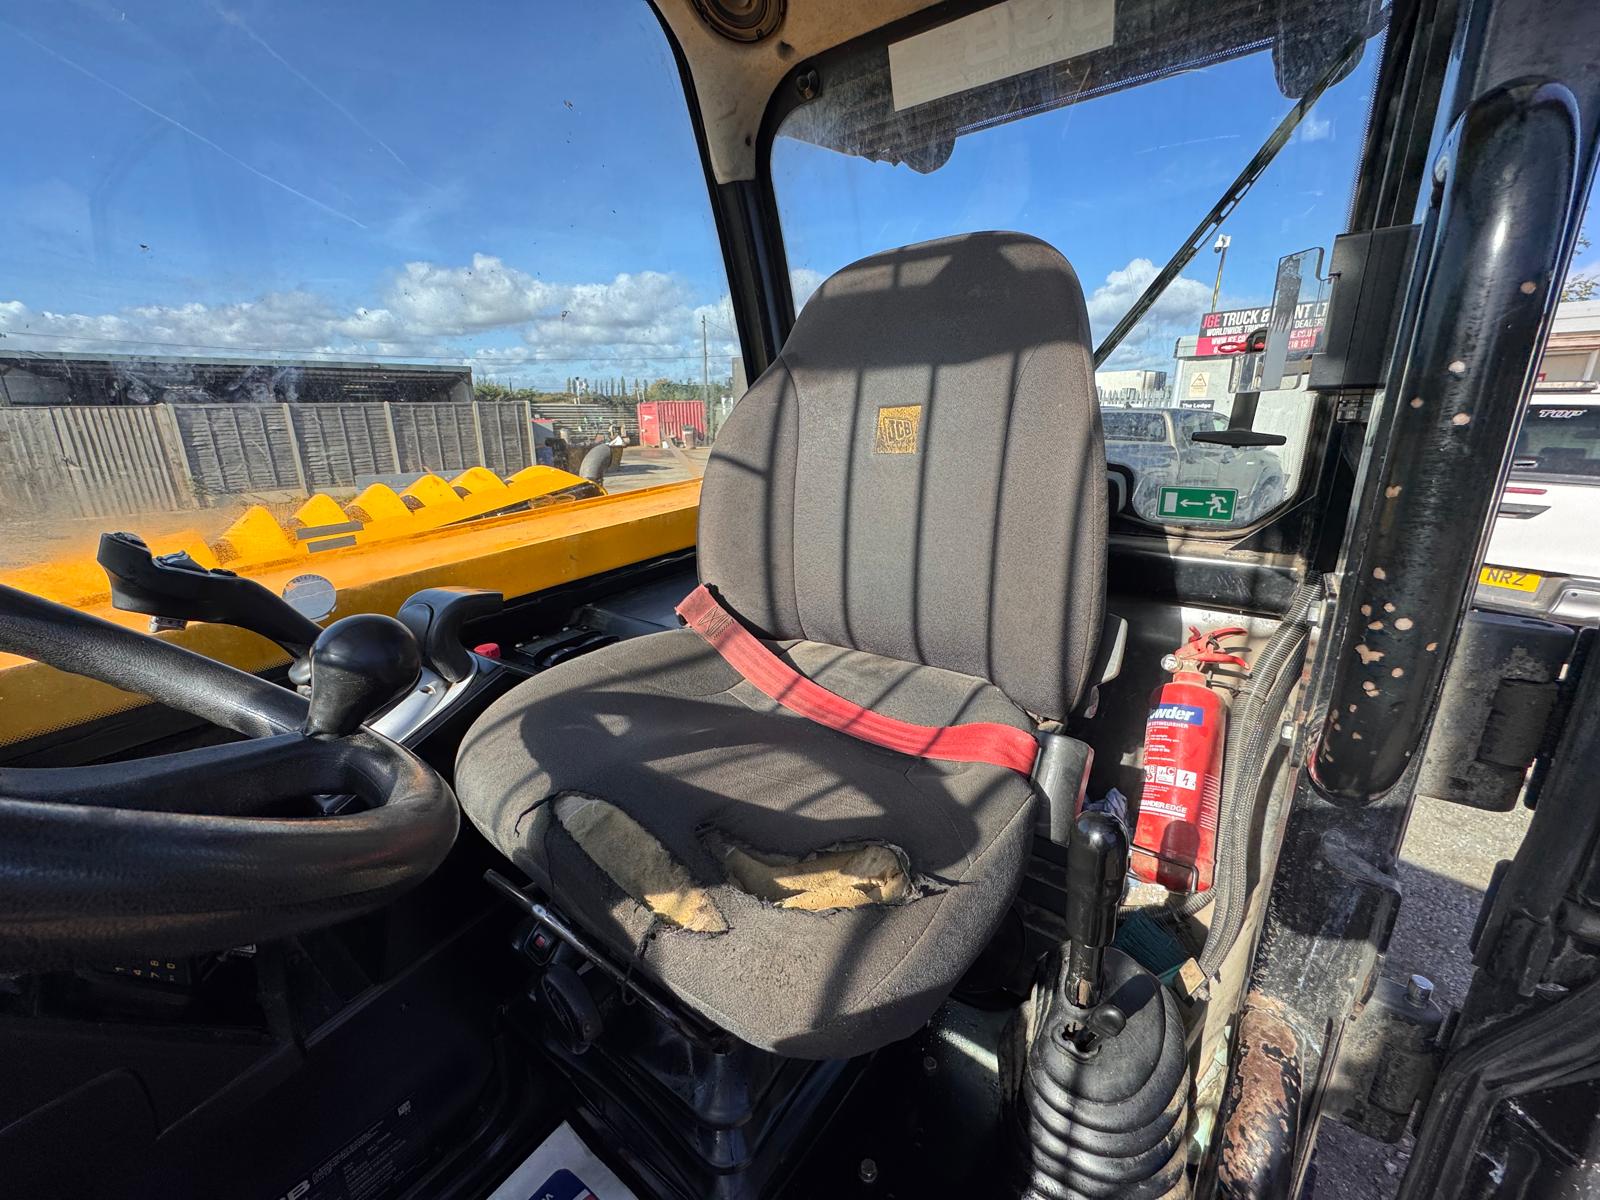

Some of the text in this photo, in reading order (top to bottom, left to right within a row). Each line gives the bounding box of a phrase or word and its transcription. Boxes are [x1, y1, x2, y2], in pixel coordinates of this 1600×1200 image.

[1222, 310, 1260, 326] TRUCK
[1260, 308, 1270, 322] &
[1206, 326, 1243, 337] WORLDWIDE
[1486, 568, 1527, 586] NRZ
